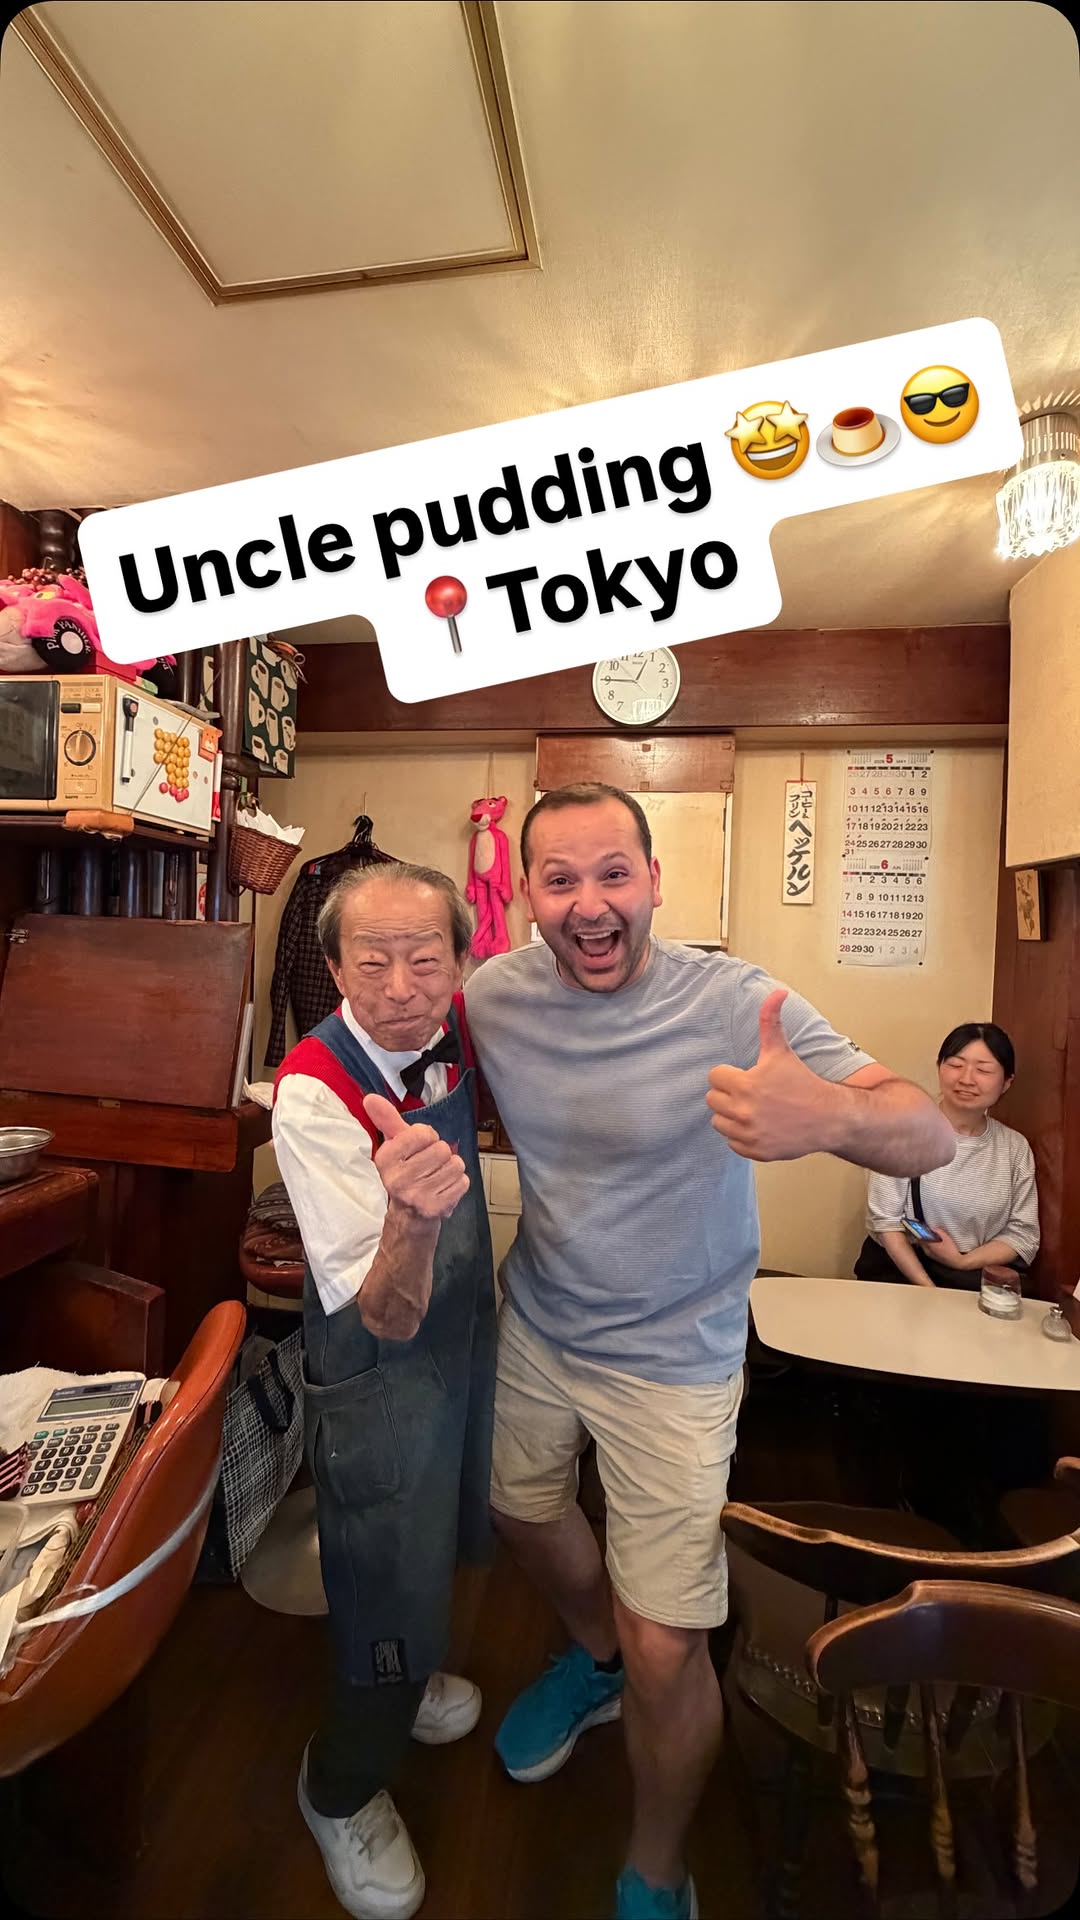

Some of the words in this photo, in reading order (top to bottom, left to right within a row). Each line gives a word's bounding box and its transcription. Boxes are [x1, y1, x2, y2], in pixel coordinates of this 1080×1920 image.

[609, 661, 619, 670] 10
[659, 663, 665, 673] 2
[662, 678, 669, 688] 3
[608, 690, 615, 700] 8
[617, 701, 624, 711] 7
[886, 754, 893, 764] 5
[787, 819, 812, 896] ヘッケルン
[881, 860, 888, 870] 6
